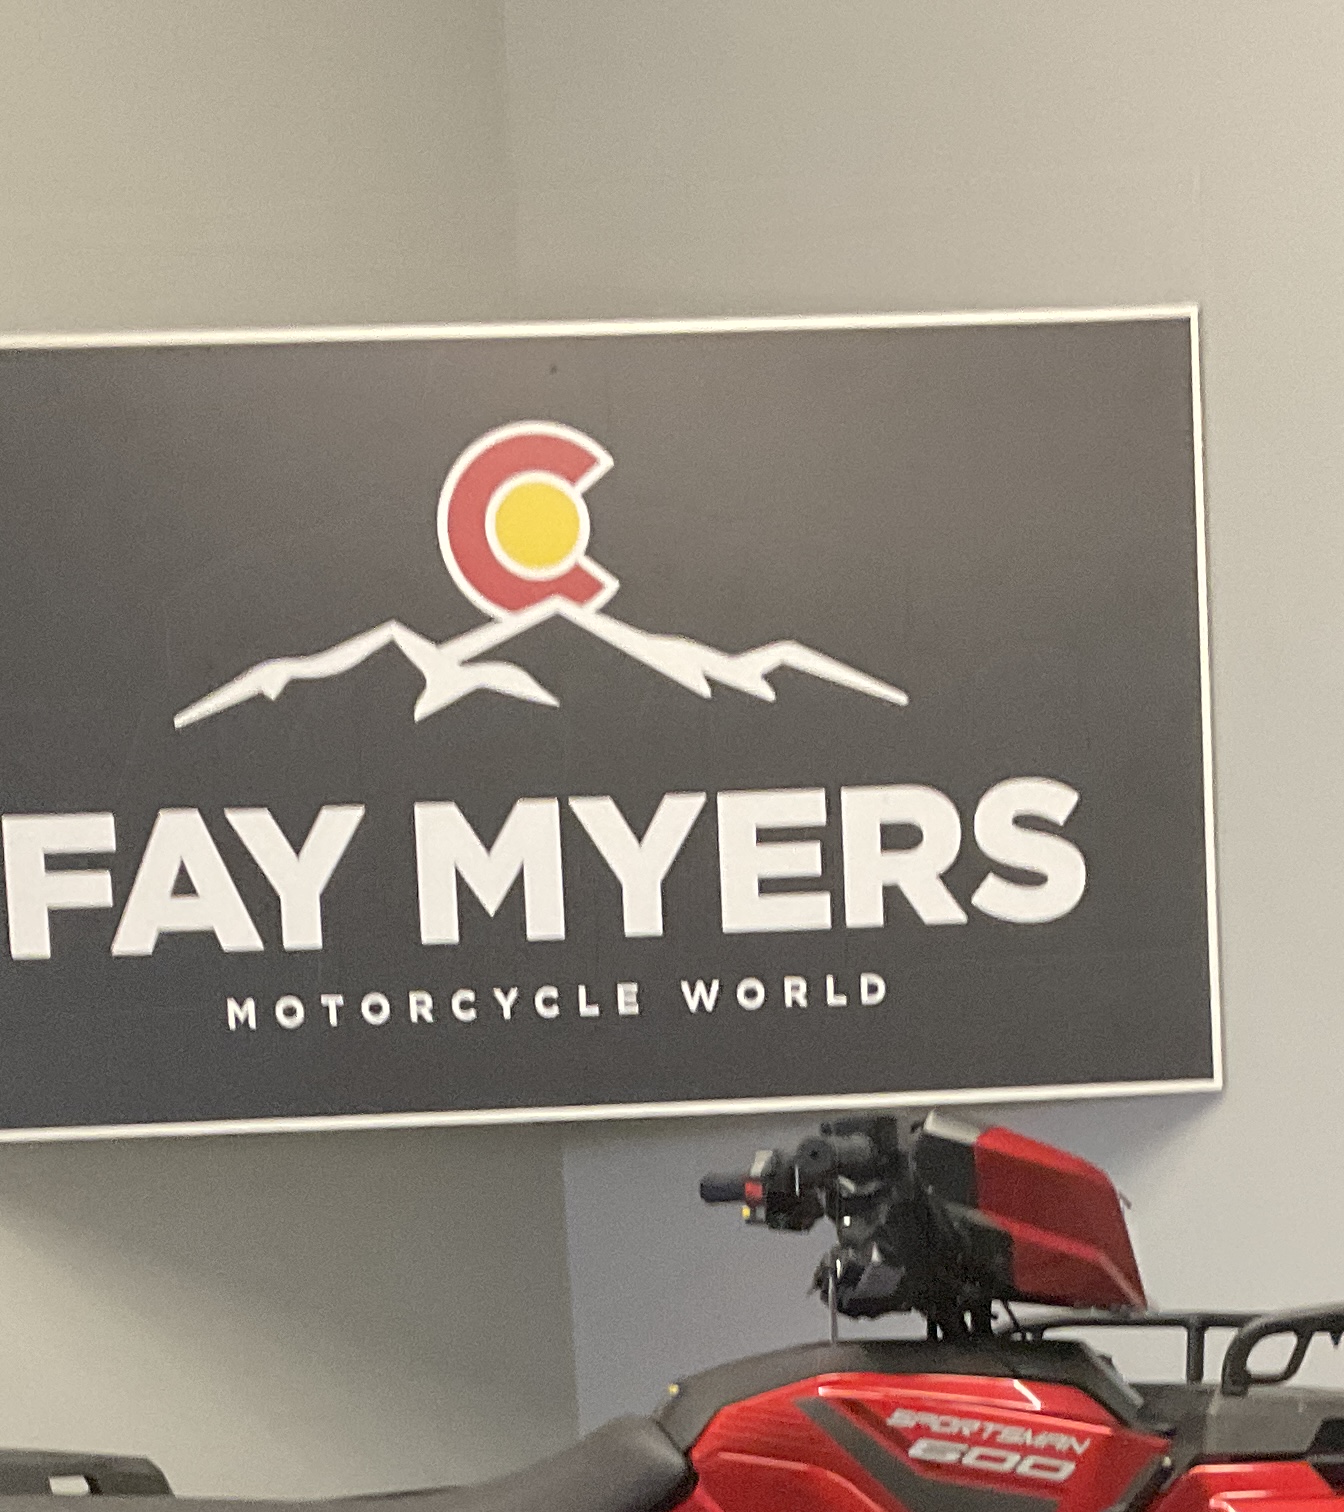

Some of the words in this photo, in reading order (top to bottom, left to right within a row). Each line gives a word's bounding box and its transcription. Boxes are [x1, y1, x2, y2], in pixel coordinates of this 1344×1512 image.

[0, 806, 365, 960] FAY
[413, 777, 1087, 945] MYERS
[226, 981, 642, 1032] MOTORCYCLE
[680, 972, 888, 1014] WORLD
[886, 1408, 1090, 1455] SPORTSMAN
[908, 1437, 1076, 1482] 600
